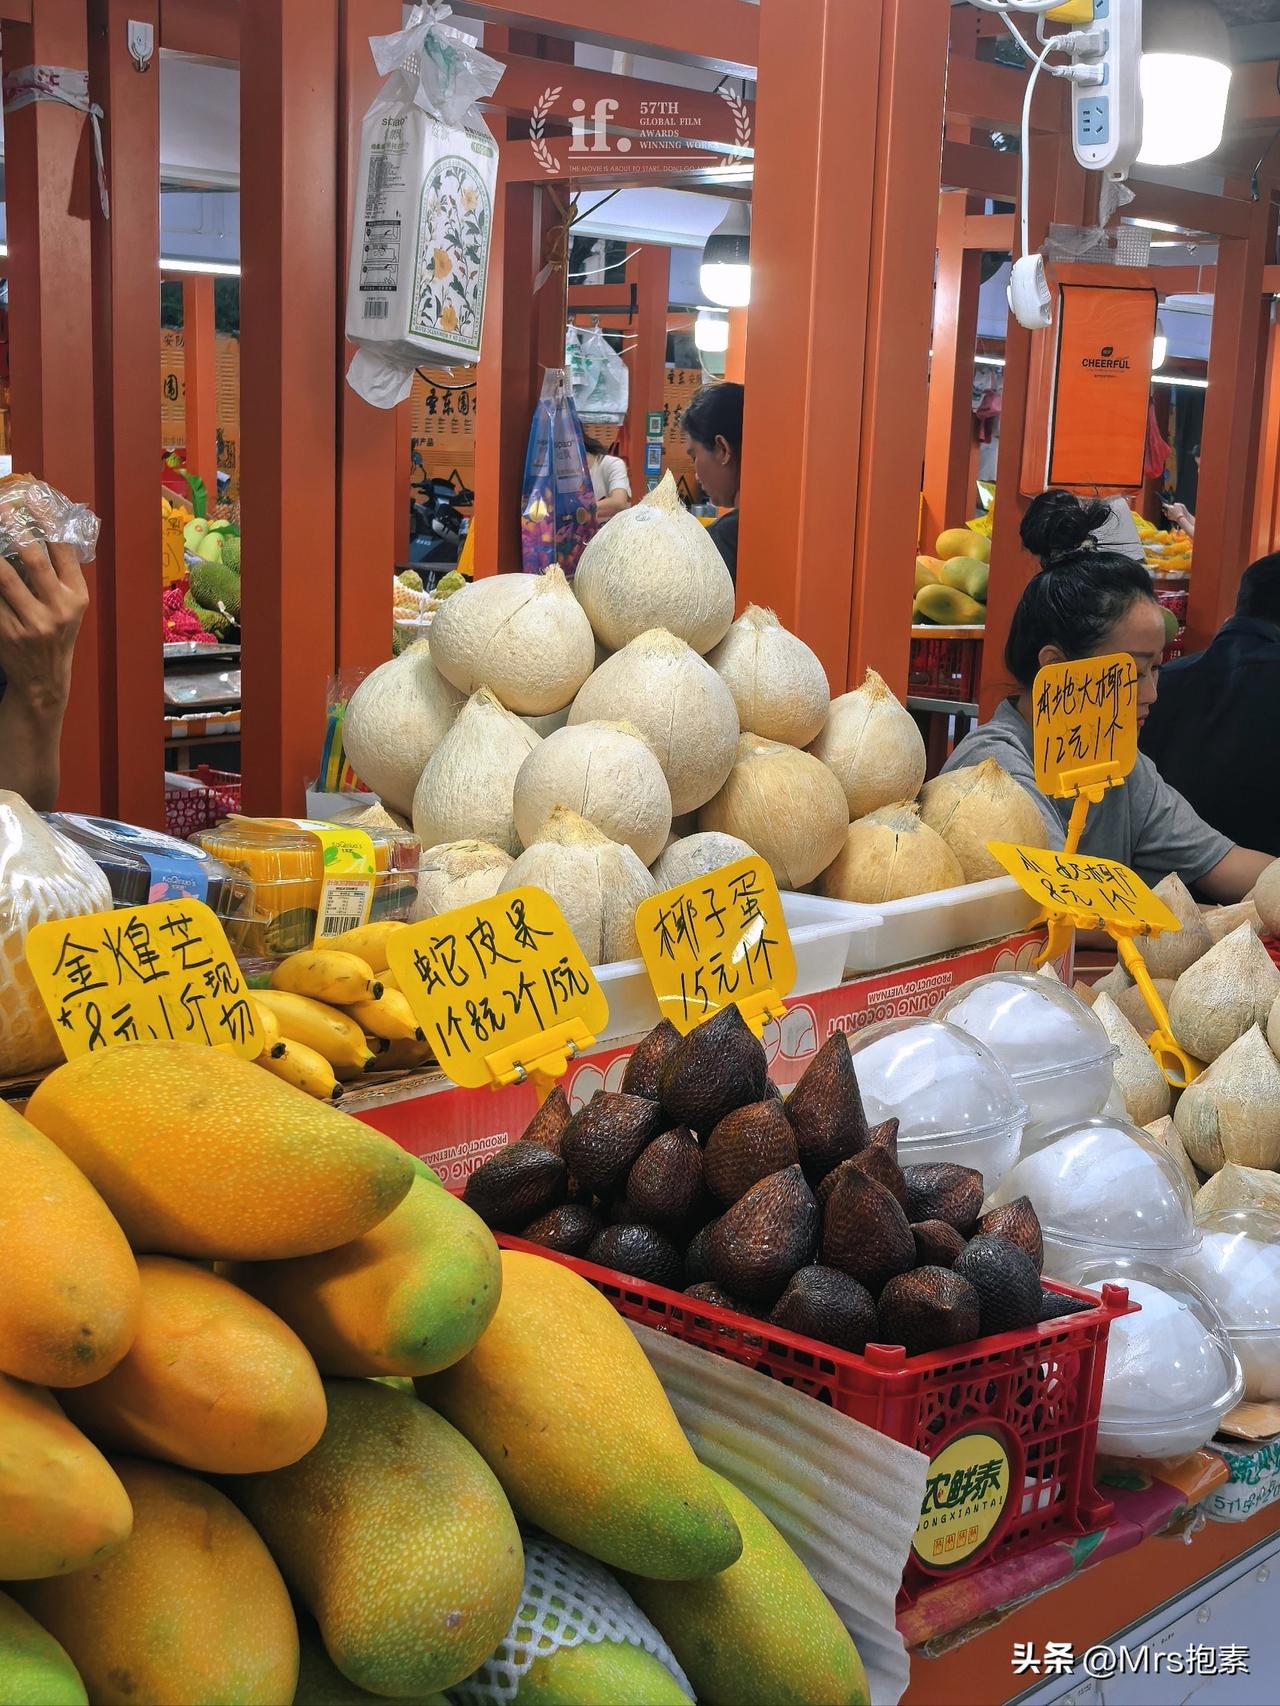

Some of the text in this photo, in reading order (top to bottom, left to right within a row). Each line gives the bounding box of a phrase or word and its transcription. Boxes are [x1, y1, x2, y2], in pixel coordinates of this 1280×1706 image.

[1081, 358, 1131, 369] CHEERFUL
[1036, 662, 1138, 728] 本地大椰子
[653, 870, 768, 962] 椰子蛋
[52, 912, 214, 1003] 金煌芒
[413, 898, 554, 995] 蛇皮果
[680, 929, 779, 1021] 15元1个
[867, 972, 952, 1004] PRODUCT OF VIETNAM
[827, 1002, 896, 1036] COCONUT
[457, 1143, 470, 1156] OF
[470, 1132, 508, 1152] PRODUCT
